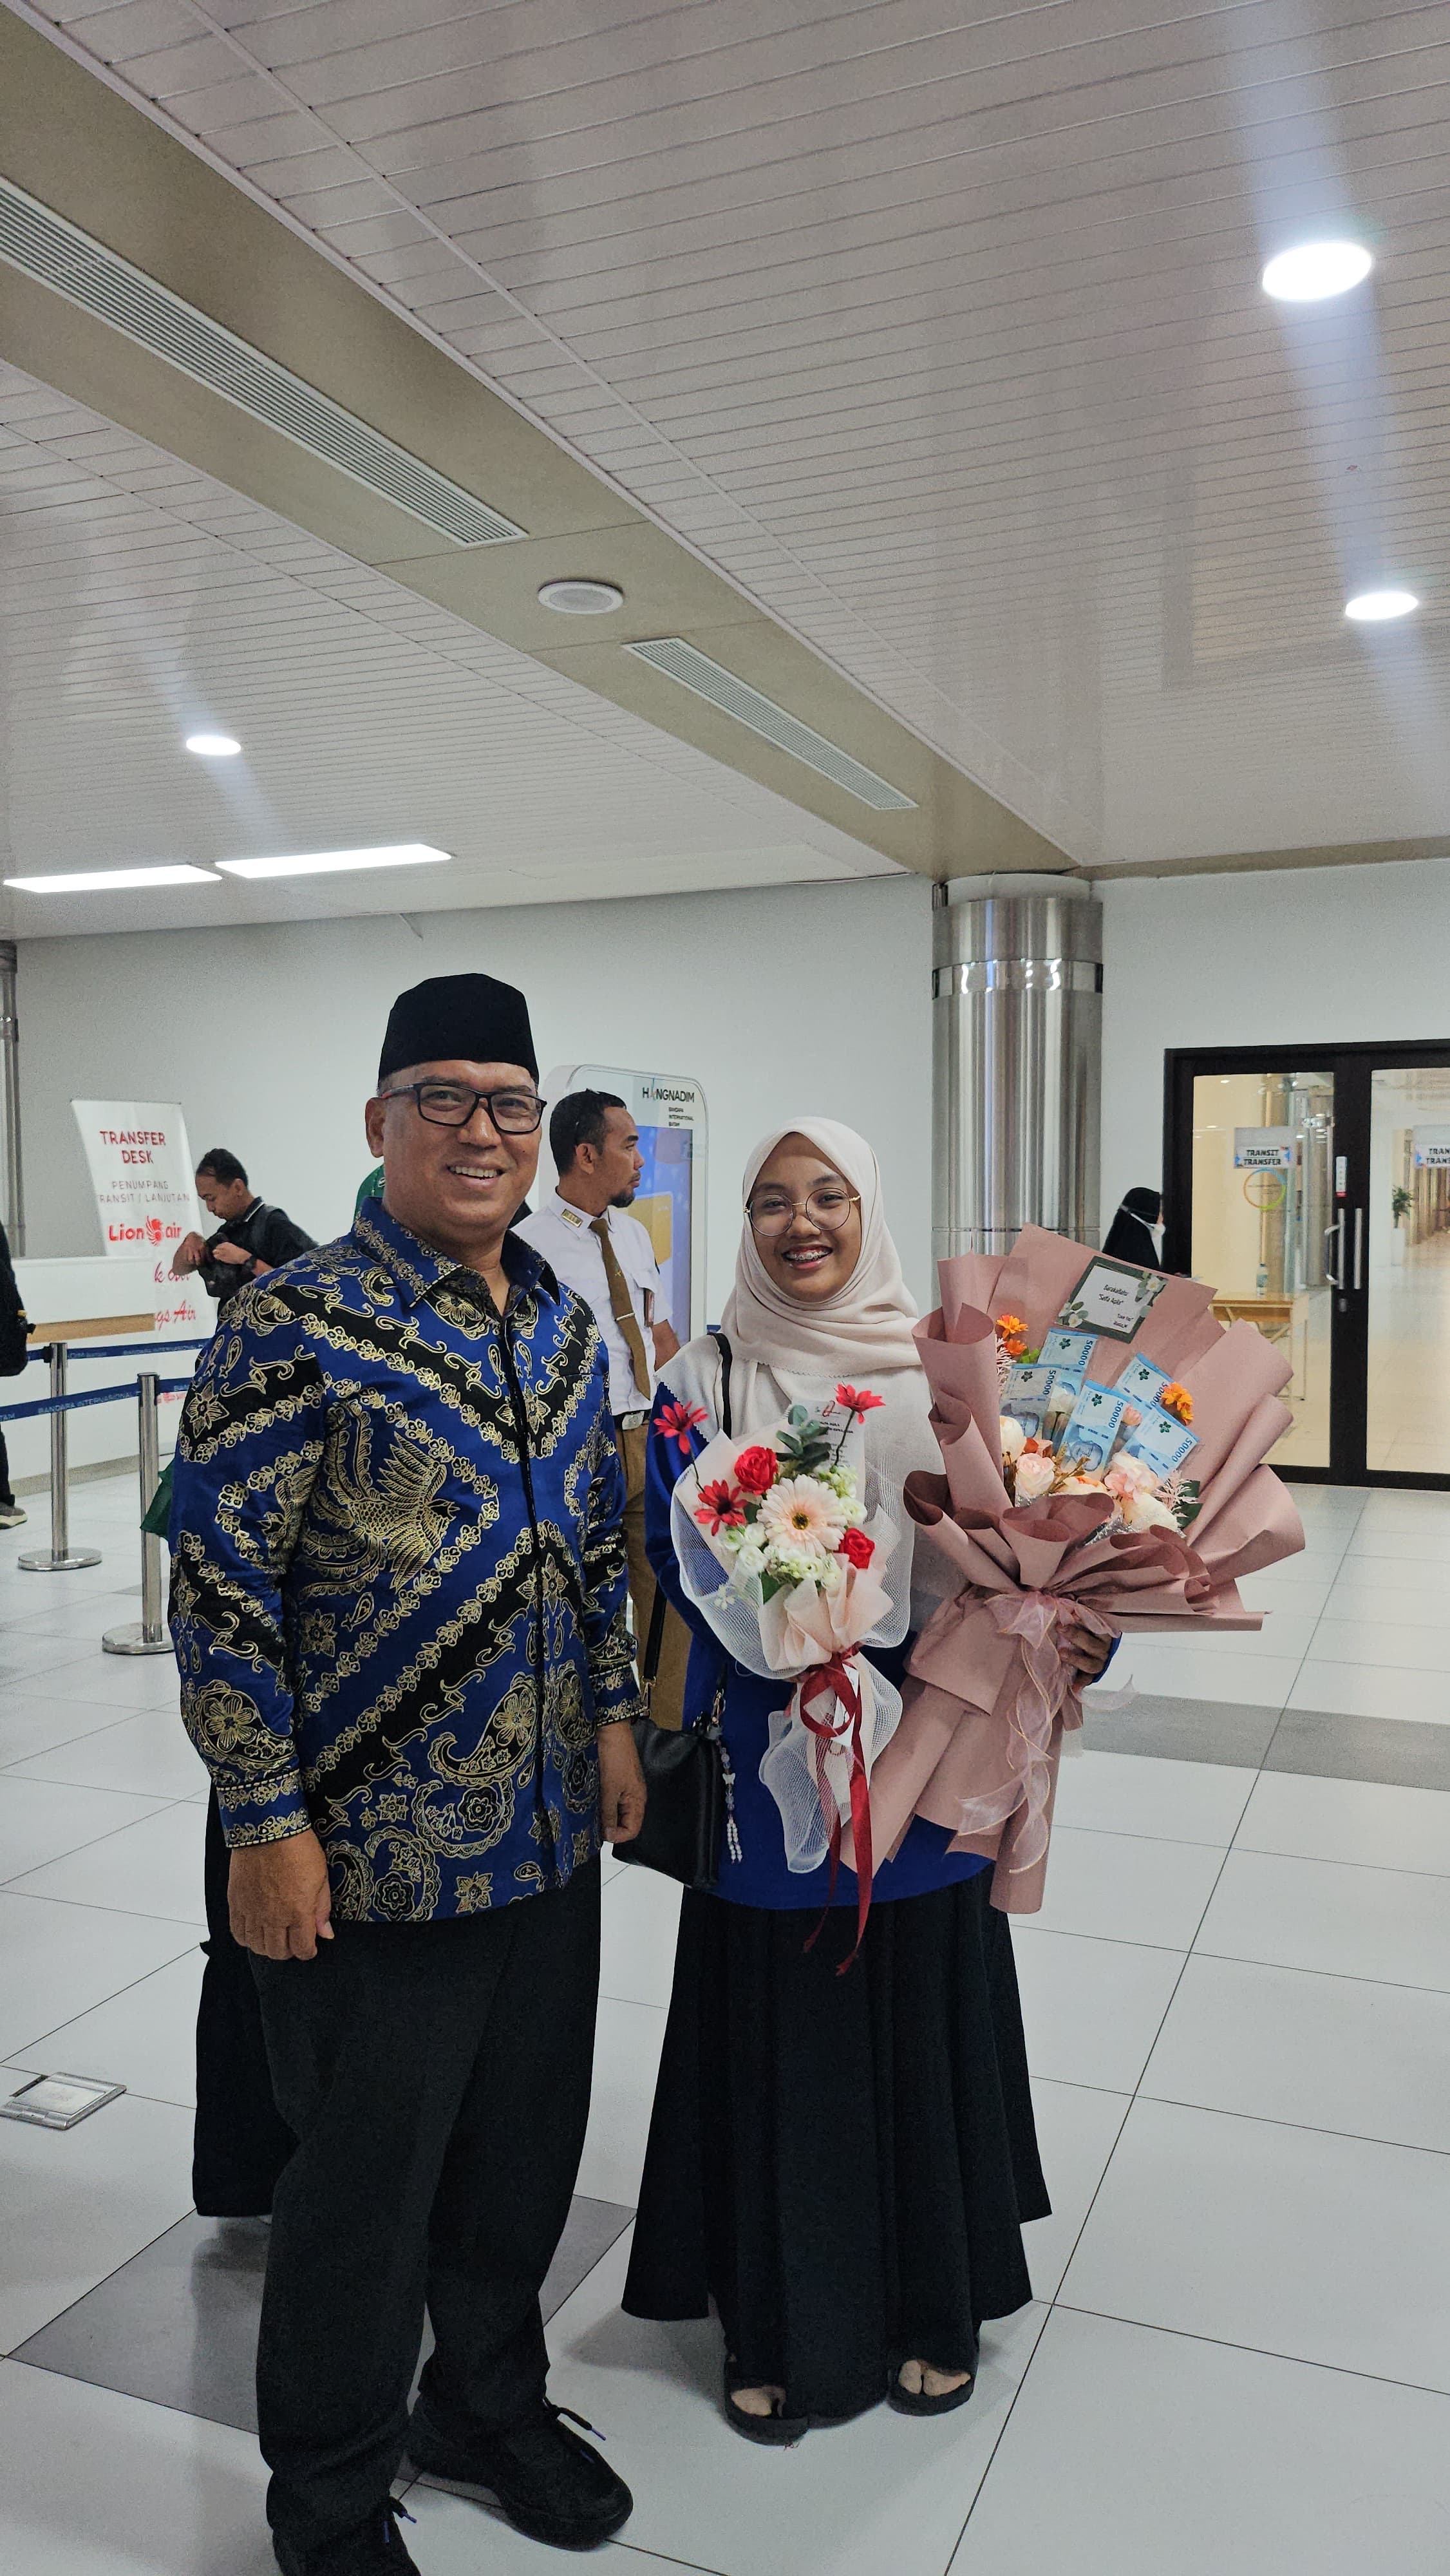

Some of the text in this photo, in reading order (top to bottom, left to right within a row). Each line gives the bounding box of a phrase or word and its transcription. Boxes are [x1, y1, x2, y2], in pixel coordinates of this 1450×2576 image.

[100, 1131, 166, 1146] TRANSFER
[121, 1150, 154, 1164] DESK
[112, 1180, 169, 1189] PENUMPANG
[145, 1193, 189, 1202] LANJUTAN
[108, 1222, 183, 1242] Lion air
[1078, 1340, 1093, 1366] 50000
[1043, 1370, 1057, 1395] 50000
[1150, 1381, 1169, 1407] 50000
[1108, 1401, 1124, 1428] 50000
[1171, 1437, 1192, 1463] 50000
